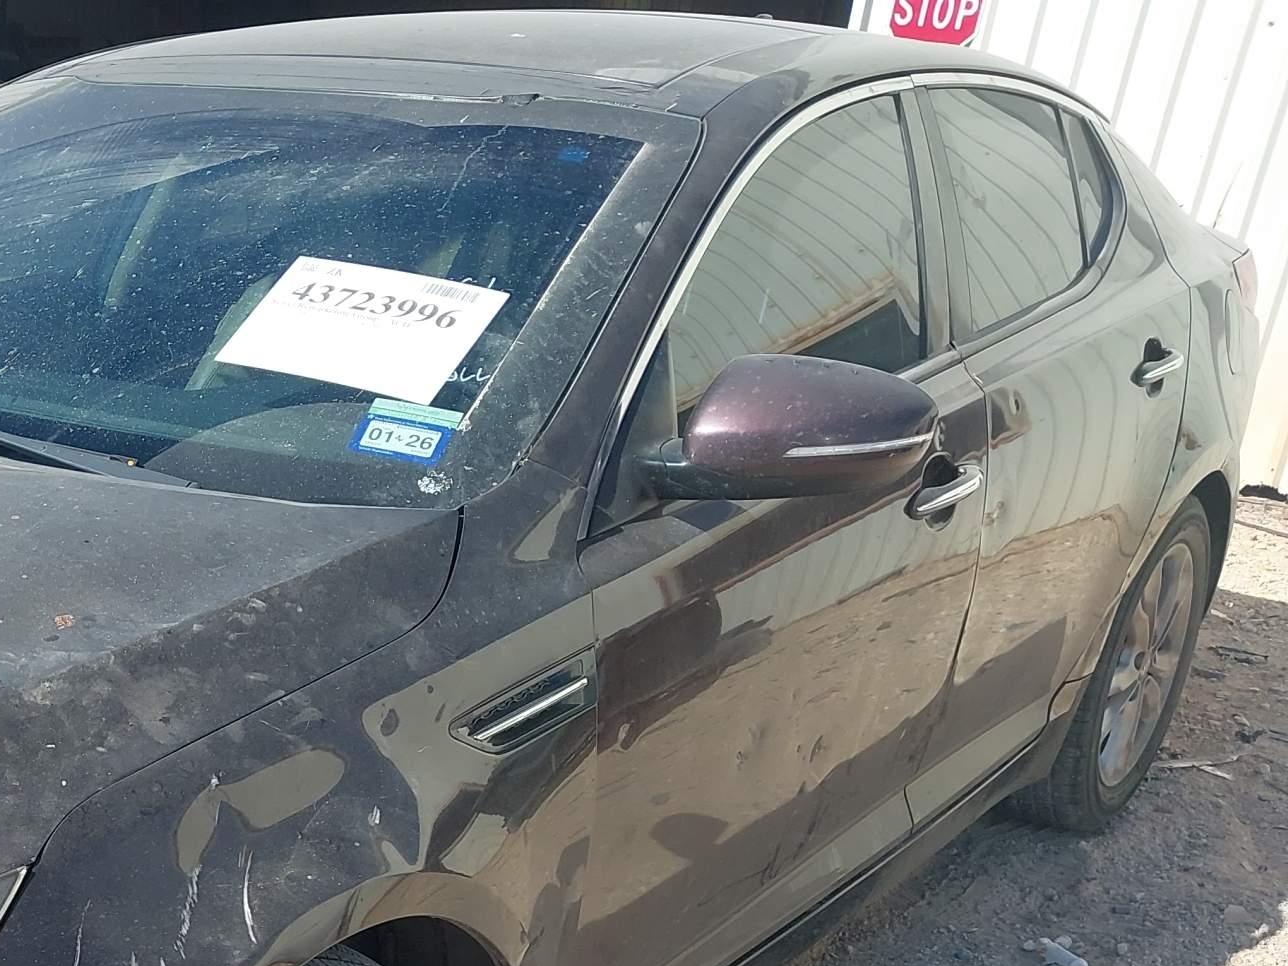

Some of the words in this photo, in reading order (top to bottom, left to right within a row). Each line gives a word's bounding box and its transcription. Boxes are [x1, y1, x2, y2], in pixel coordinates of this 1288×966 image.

[894, 0, 979, 30] STOP
[292, 282, 463, 329] 43723996
[368, 427, 394, 443] 01
[405, 434, 435, 450] 26
